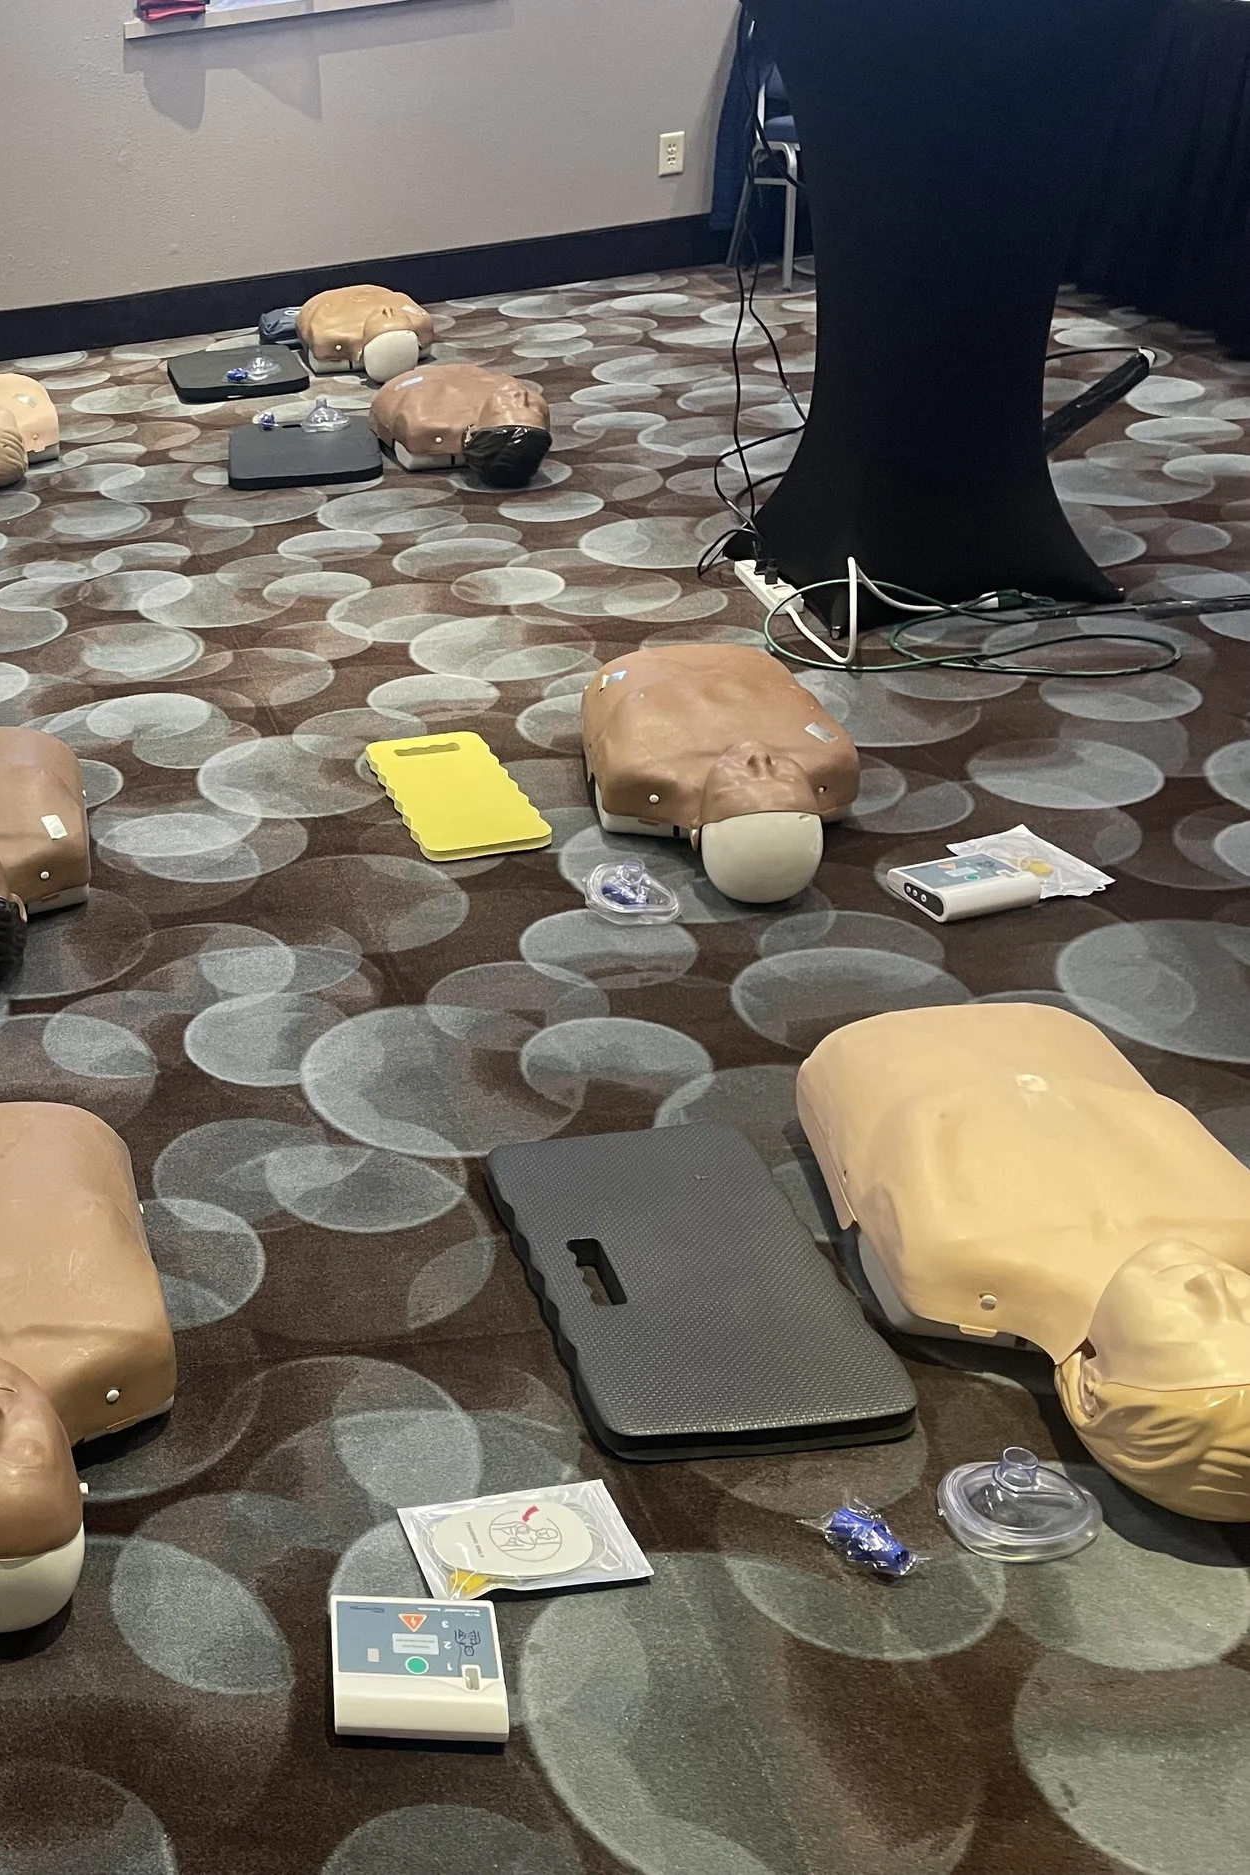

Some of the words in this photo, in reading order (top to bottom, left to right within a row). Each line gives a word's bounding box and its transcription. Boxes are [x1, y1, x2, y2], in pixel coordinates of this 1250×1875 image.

[441, 1620, 449, 1629] 3
[443, 1641, 452, 1650] 2
[447, 1663, 453, 1671] 1
